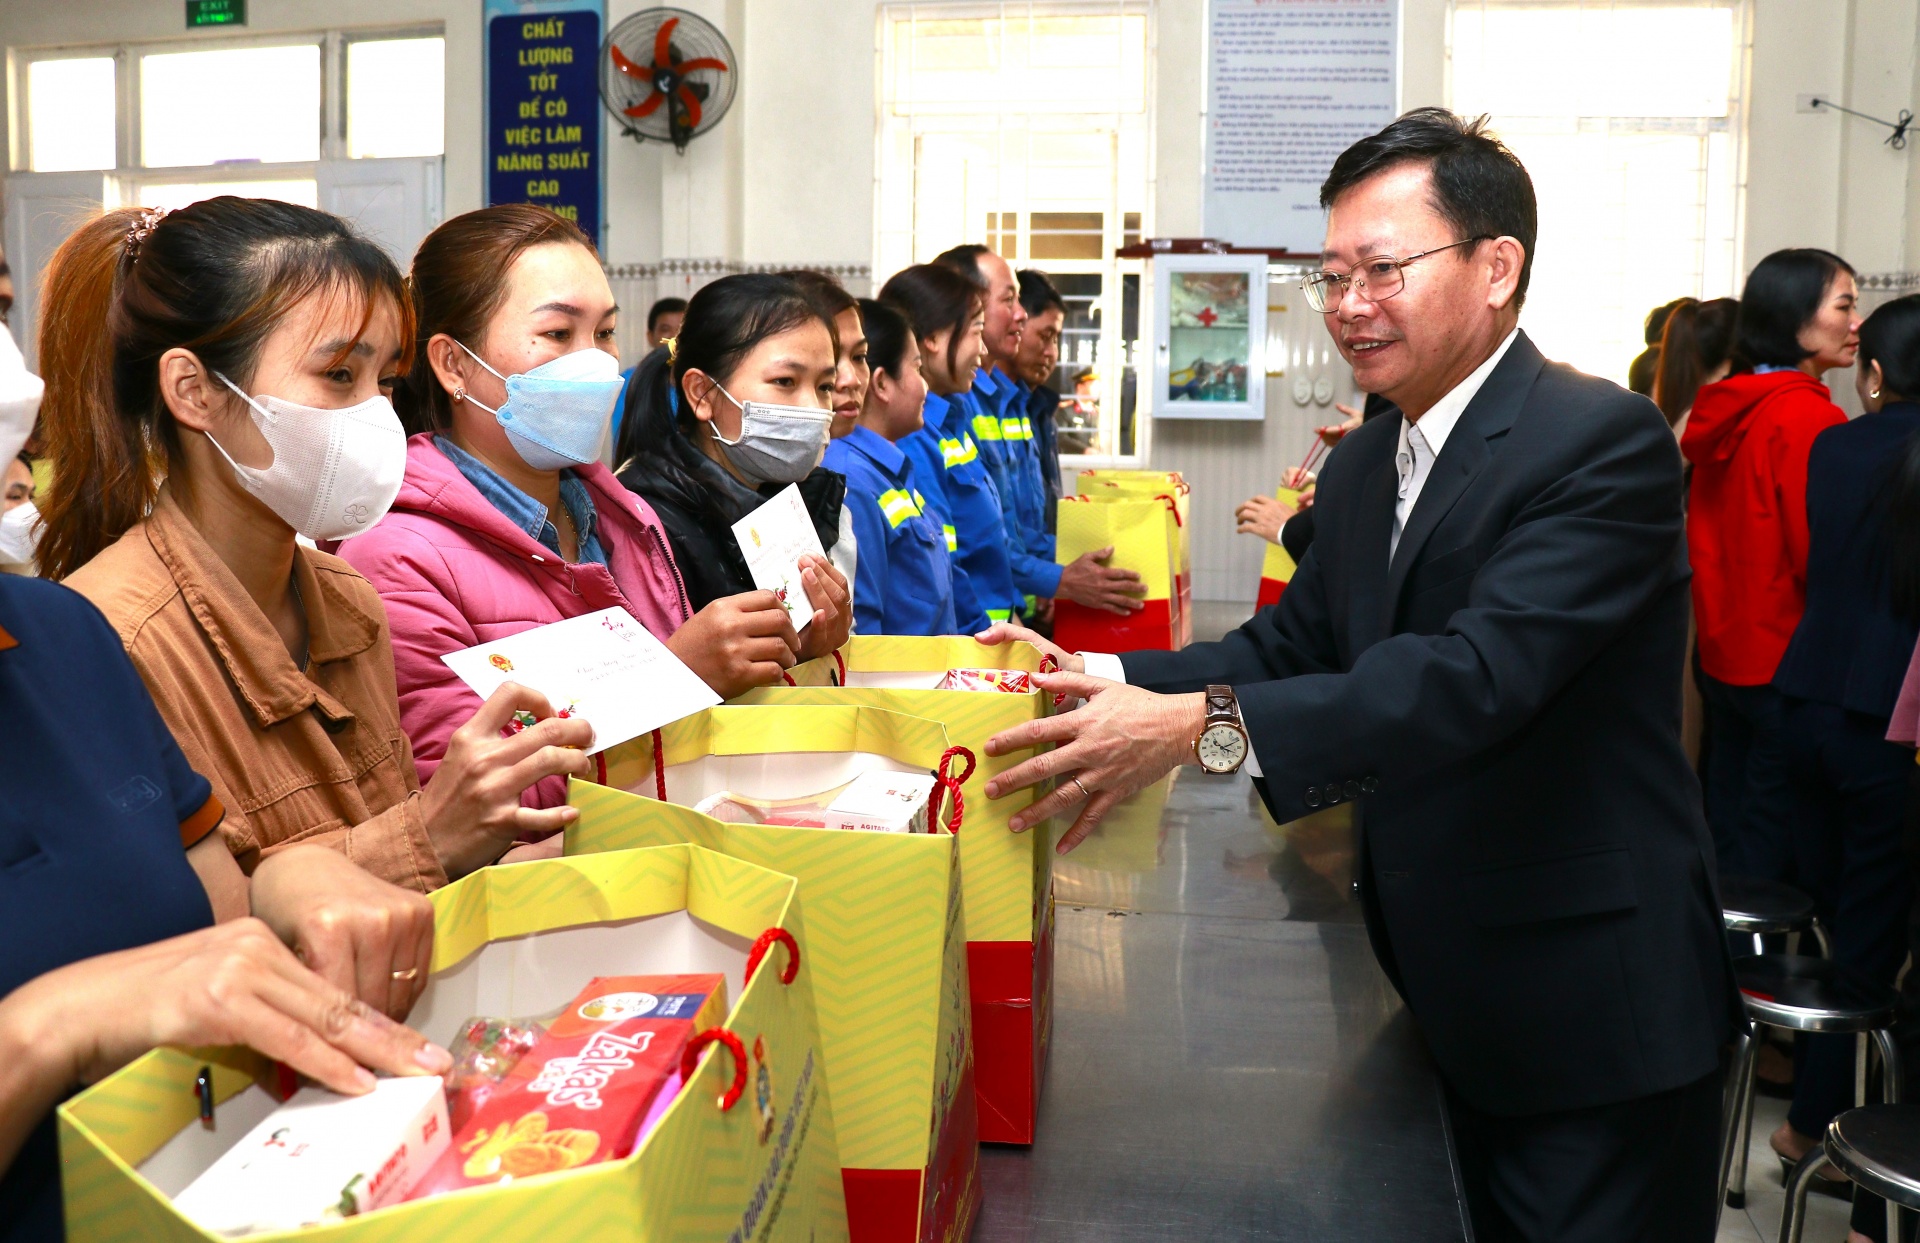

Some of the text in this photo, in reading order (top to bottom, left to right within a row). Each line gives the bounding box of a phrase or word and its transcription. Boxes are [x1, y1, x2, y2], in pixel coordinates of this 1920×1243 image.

[199, 1, 229, 11] EXIT
[522, 16, 565, 39] CHẤT
[519, 47, 573, 68] LƯỢNG
[529, 68, 558, 92] TỐT
[545, 97, 567, 117] CÓ
[505, 123, 582, 148] VIỆC LÀM
[497, 146, 590, 172] NĂNG SUẤT
[527, 180, 560, 197] CAO
[860, 823, 890, 831] AGITATO
